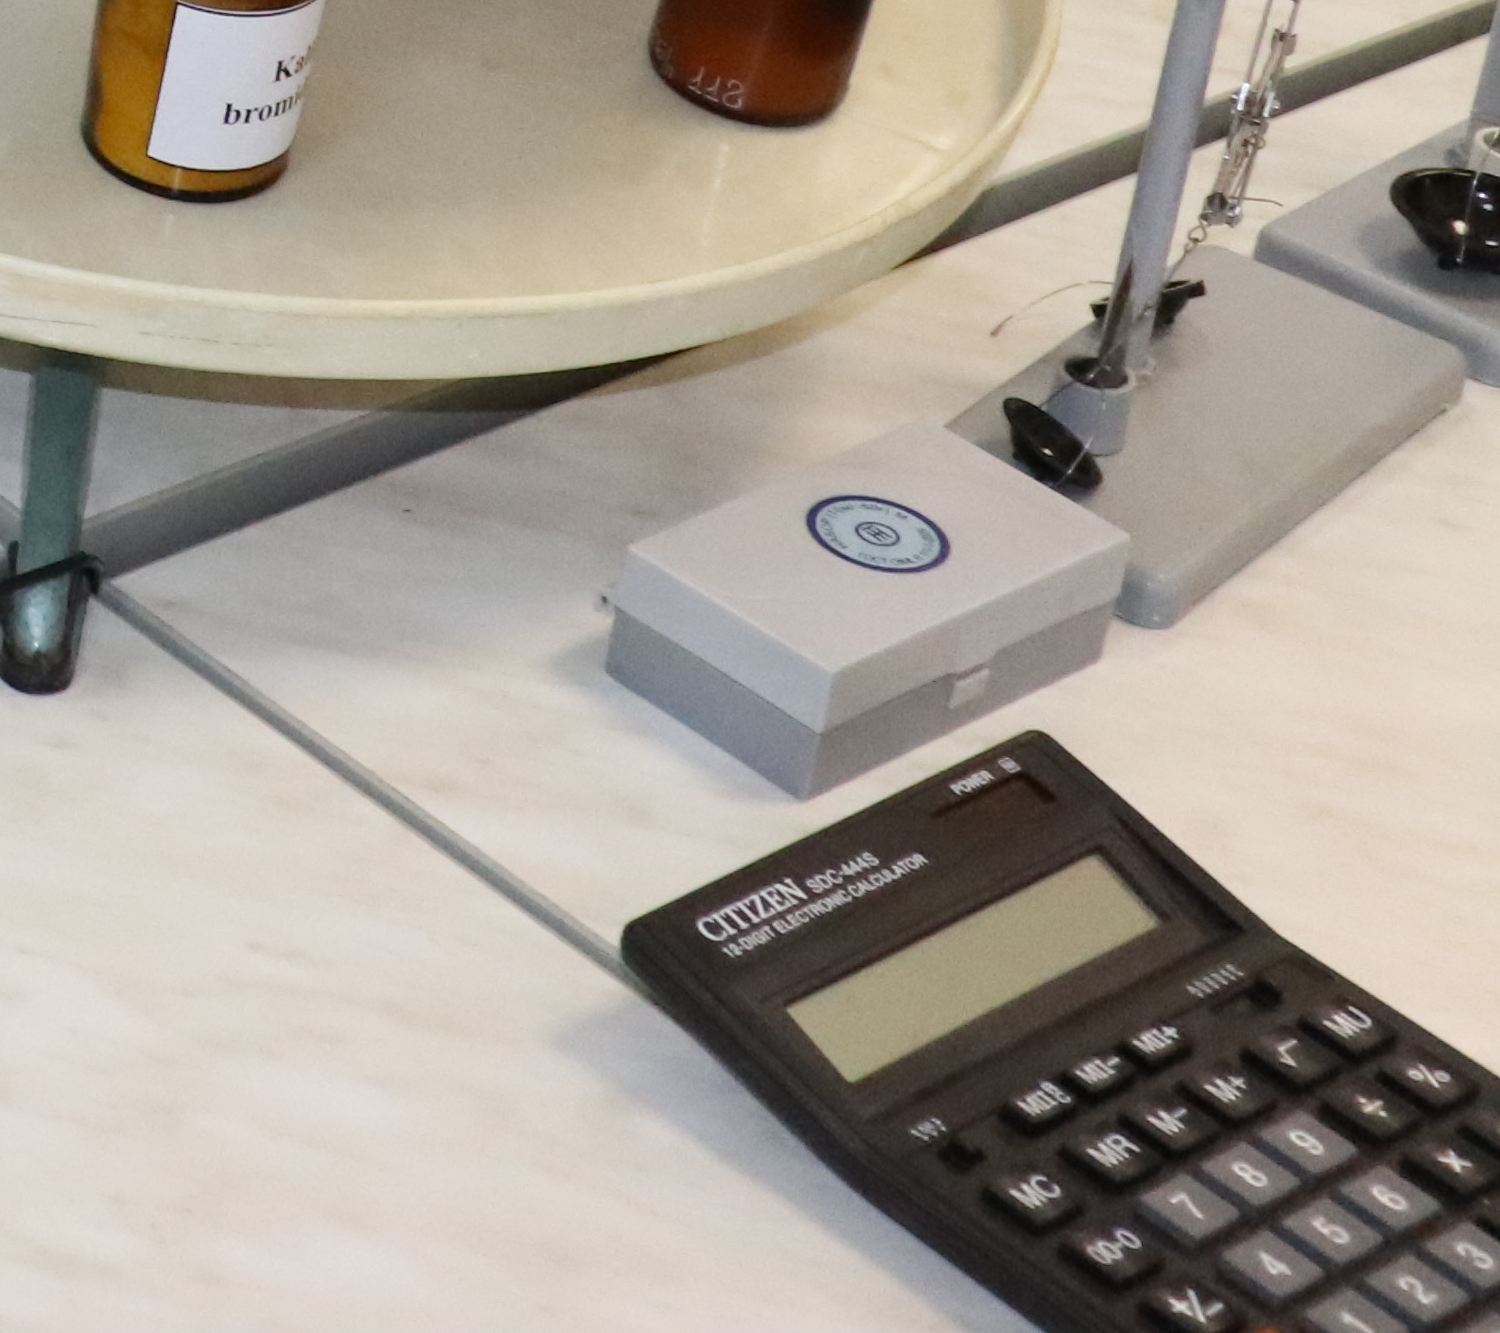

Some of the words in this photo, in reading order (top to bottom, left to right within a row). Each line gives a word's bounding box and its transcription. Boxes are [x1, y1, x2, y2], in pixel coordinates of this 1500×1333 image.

[949, 769, 995, 796] POWER
[696, 876, 807, 942] CITIZEN
[805, 851, 880, 895] SDC-444S
[722, 924, 777, 959] 12-DIGIT
[775, 887, 851, 935] ELECTRONIC
[847, 851, 929, 900] CALCULATOR
[1322, 1005, 1374, 1039] MU
[1085, 1133, 1141, 1167] MR
[1289, 1129, 1325, 1156] 9
[1231, 1160, 1268, 1188] 8
[1008, 1174, 1061, 1209] MC
[1169, 1191, 1204, 1220] 7
[1370, 1184, 1409, 1211] 6
[1311, 1216, 1350, 1245] 5
[1258, 1250, 1293, 1276] 4
[1454, 1241, 1494, 1270] 3
[1399, 1274, 1439, 1305] 2
